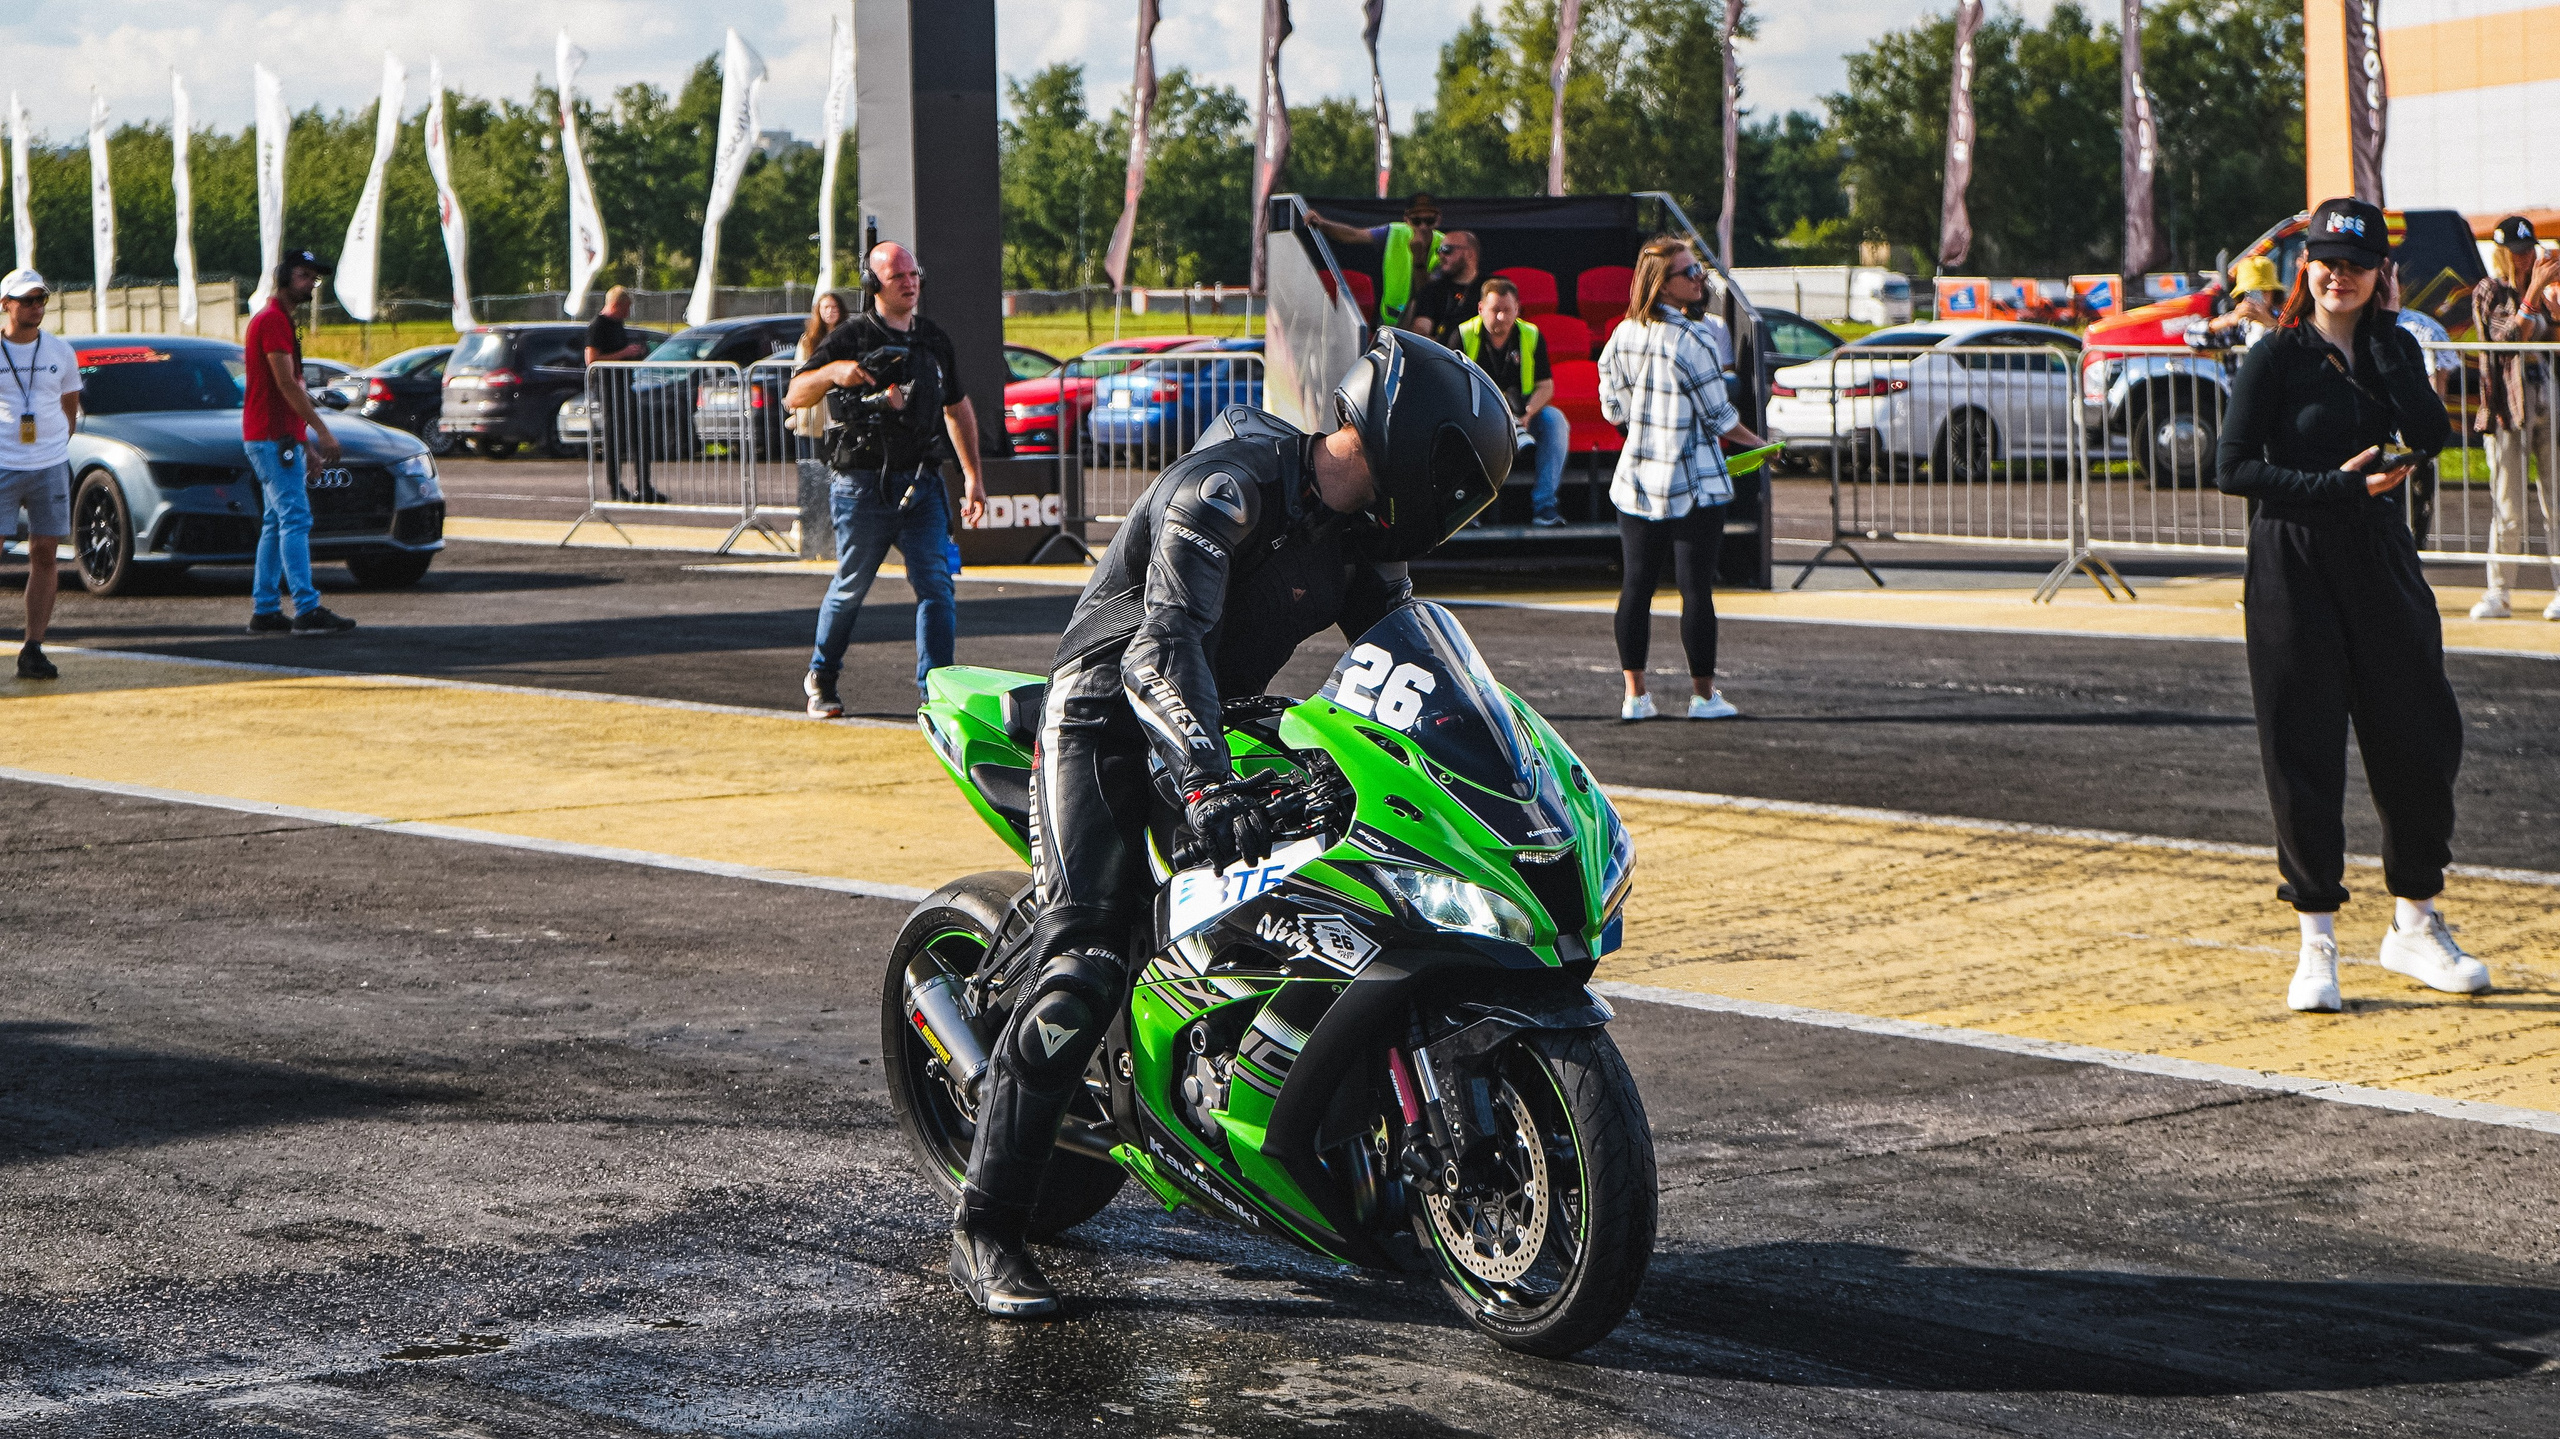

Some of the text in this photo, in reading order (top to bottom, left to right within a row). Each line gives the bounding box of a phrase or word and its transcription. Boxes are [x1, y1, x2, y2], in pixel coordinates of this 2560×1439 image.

[1333, 642, 1436, 731] 26
[1526, 827, 1562, 839] Kawasaki
[1329, 933, 1355, 951] 26
[1149, 1135, 1260, 1228] Kawasaki
